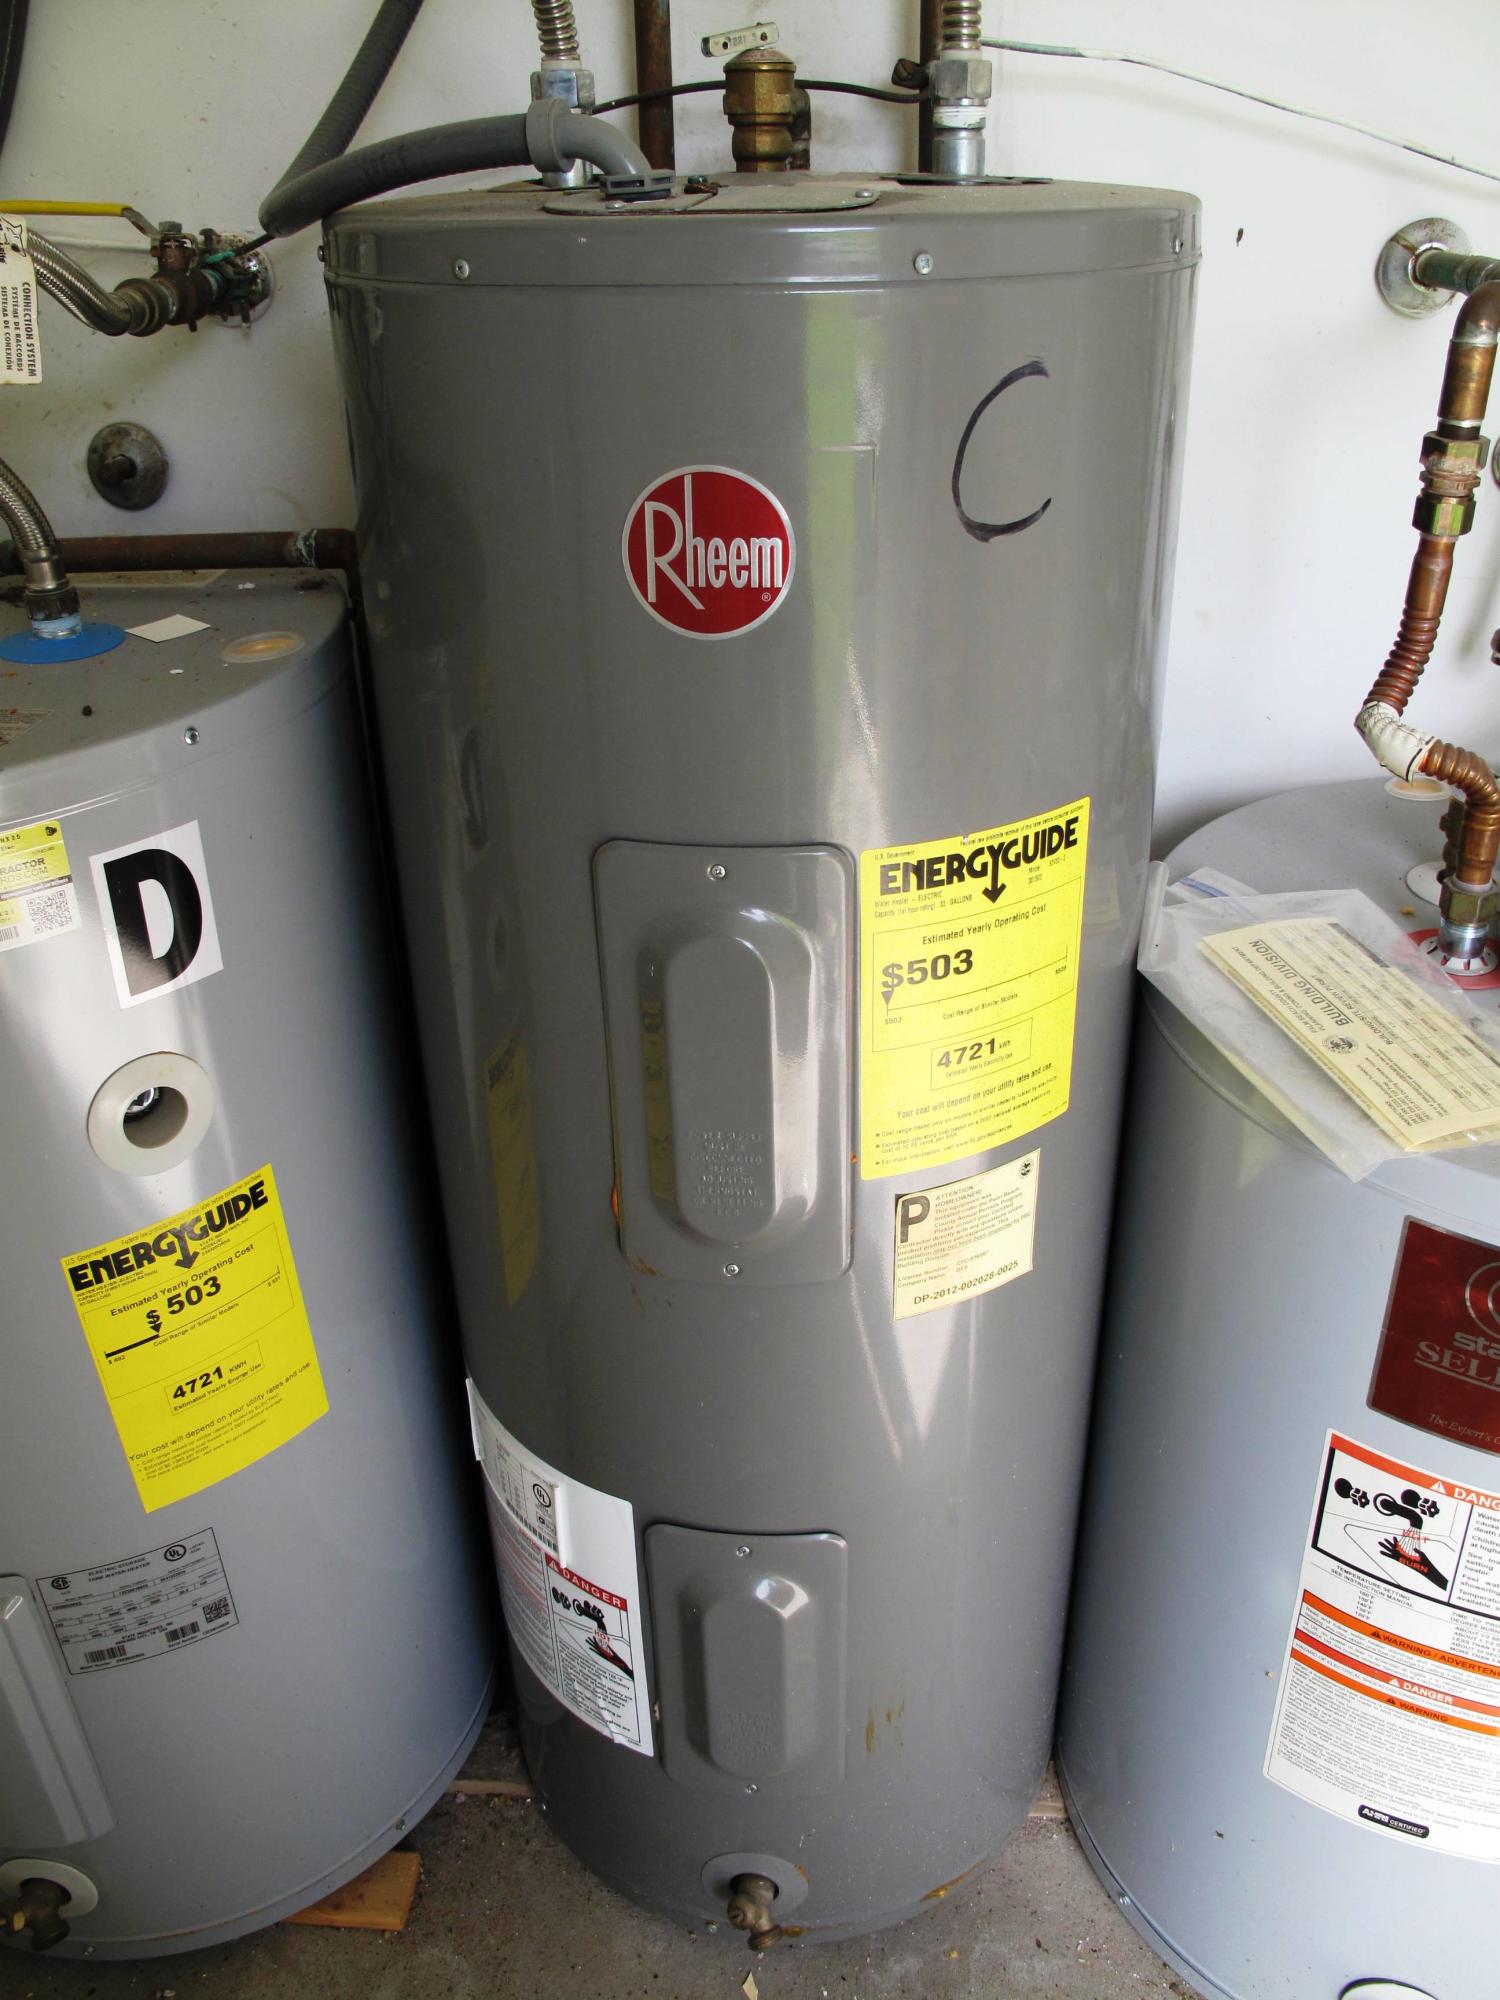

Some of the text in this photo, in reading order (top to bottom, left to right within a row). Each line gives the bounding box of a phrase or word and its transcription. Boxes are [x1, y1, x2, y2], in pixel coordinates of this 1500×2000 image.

[1, 286, 9, 317] SISTEMA
[22, 282, 37, 377] CONNECTION SYSTEM
[13, 321, 23, 371] DE RACCORDS
[952, 356, 1053, 543] C
[644, 474, 783, 610] Rheem
[880, 816, 1079, 900] ENERGYGUIDE
[918, 891, 942, 902] ELECTRIC
[949, 894, 972, 906] GALLONS
[103, 849, 202, 997] D
[922, 903, 1046, 945] Estimated Yearly Operating Cost
[881, 949, 973, 990] $503
[1246, 939, 1350, 1027] BUILDING DIVISION
[1310, 973, 1333, 991] PERMIT
[1000, 992, 1018, 1004] Models
[1330, 991, 1355, 1010] REVIEW
[936, 1037, 996, 1069] 4721
[897, 1066, 1041, 1119] Your cost will depend on your utility rates and
[1383, 1100, 1413, 1127] INSPECTIONS
[935, 1184, 975, 1201] ATTENTION
[935, 1193, 992, 1214] This equipment was
[961, 1203, 978, 1214] under
[1003, 1186, 1020, 1197] Beach
[899, 1194, 931, 1244] P
[934, 1202, 1000, 1229] County Annual Permits
[934, 1202, 1014, 1235] Please contact your Certified
[69, 1180, 269, 1292] ENERGYGUIDE
[897, 1212, 1007, 1250] Contractor directly with any questions
[897, 1217, 1009, 1257] product problems you This
[897, 1258, 924, 1268] Building
[111, 1243, 255, 1317] Estimated Yearly Operating Cost
[897, 1278, 928, 1288] Company
[913, 1260, 1019, 1305] DP-2012-002028-0025
[146, 1276, 221, 1325] $ 503
[173, 1361, 247, 1399] 4721 KWH
[174, 1363, 261, 1412] Estimated Yearly Energy Use
[130, 1362, 310, 1461] Your cost will depend on your utility rates and use
[1430, 1413, 1491, 1442] The Expert's
[1453, 1487, 1500, 1511] DANG
[1474, 1526, 1497, 1537] death
[1476, 1519, 1500, 1530] cause
[1477, 1511, 1500, 1523] Water
[1465, 1559, 1494, 1572] setting
[1467, 1552, 1483, 1561] See
[562, 1570, 621, 1607] DANGER
[1330, 1568, 1413, 1609] SEE INSTRUCTION MANUAL
[1336, 1565, 1411, 1602] TEMPERATURE SETTING
[1462, 1573, 1479, 1583] Feel
[1382, 1634, 1431, 1657] WARNING
[1452, 1636, 1490, 1650] LESS THAN
[1454, 1631, 1477, 1641] ABOUT
[1455, 1626, 1478, 1636] ABOUT
[1450, 1646, 1470, 1655] MORE
[1402, 1680, 1454, 1705] DANGER
[1399, 1701, 1448, 1723] WARNING
